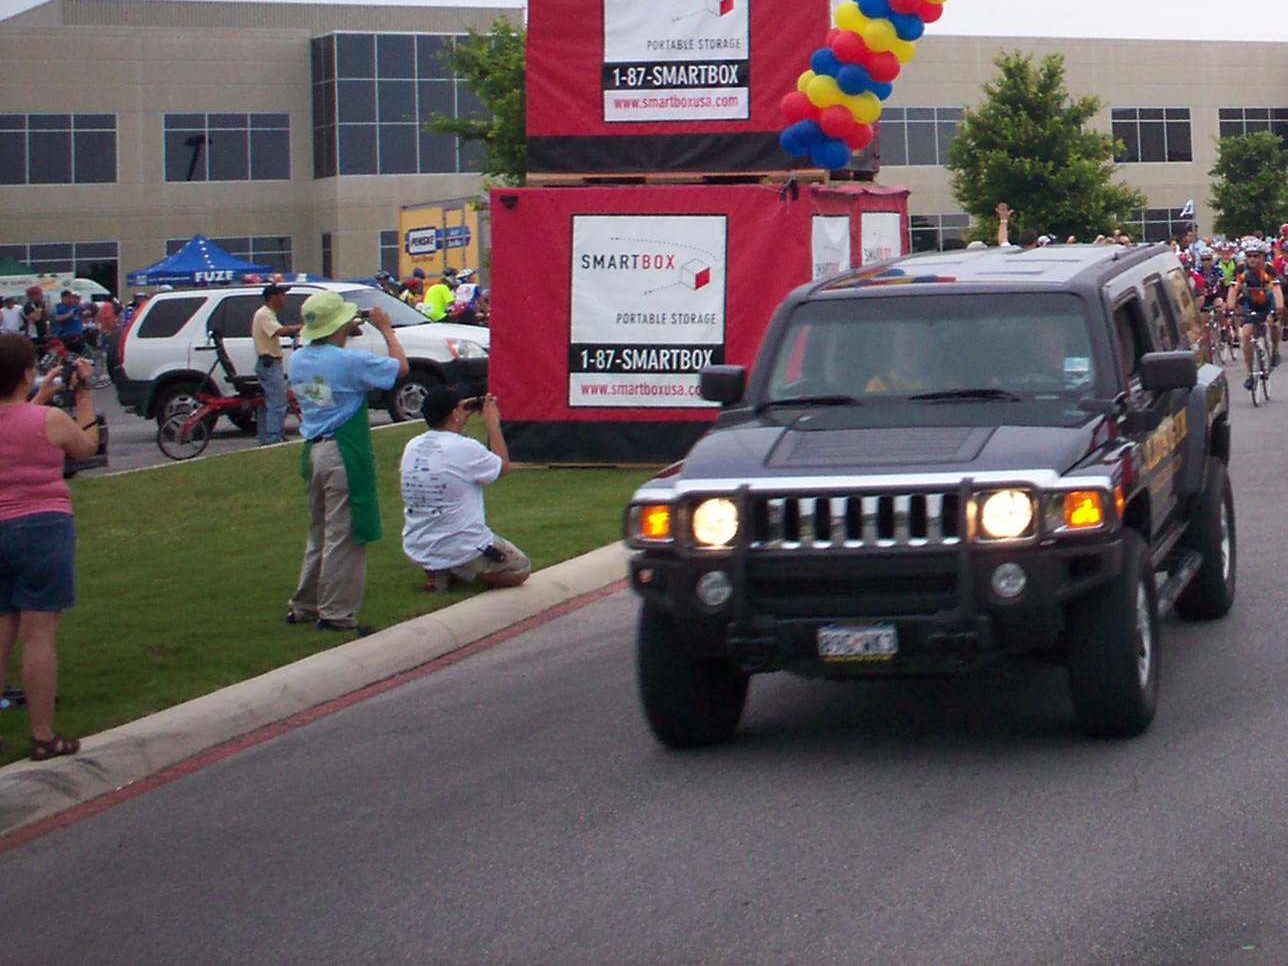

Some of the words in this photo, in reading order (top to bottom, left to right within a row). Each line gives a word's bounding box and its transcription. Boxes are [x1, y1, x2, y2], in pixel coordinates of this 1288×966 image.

[647, 38, 694, 50] PORTABLE
[698, 37, 741, 50] STORAGE
[613, 64, 739, 86] 1-87-SMARTBOX
[613, 94, 739, 109] www.smartboxusa.com
[581, 254, 675, 270] SMARTBOX
[194, 270, 234, 282] FUZE
[616, 313, 666, 325] PORTABLE
[671, 313, 717, 325] STORAGE
[581, 349, 713, 370] 1-87-SMARTBOX
[581, 382, 700, 396] www.smartboxusa.co
